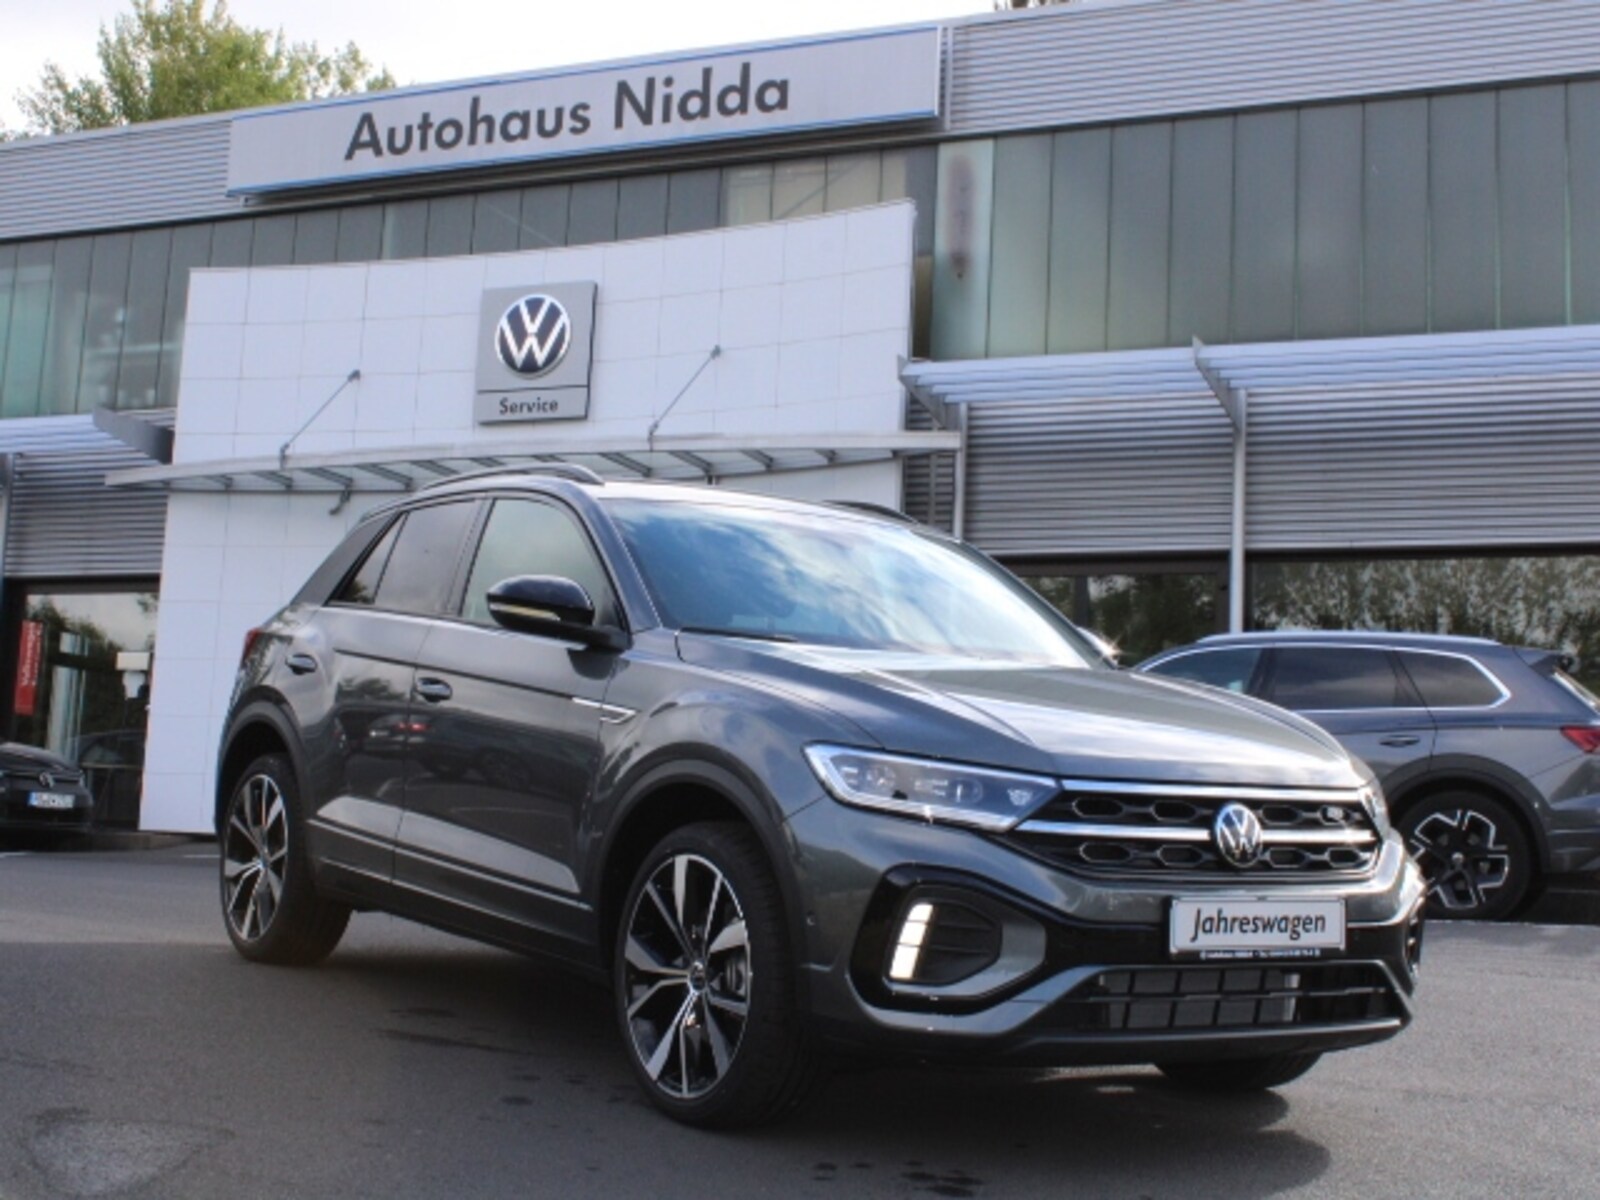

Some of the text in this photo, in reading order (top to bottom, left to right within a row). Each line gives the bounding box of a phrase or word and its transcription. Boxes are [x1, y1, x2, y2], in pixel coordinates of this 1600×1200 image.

[345, 63, 790, 161] Autohaus Nidda
[495, 293, 571, 376] VW
[499, 397, 559, 415] Service
[1215, 803, 1263, 867] VW
[1190, 908, 1327, 942] Jahreswagen
